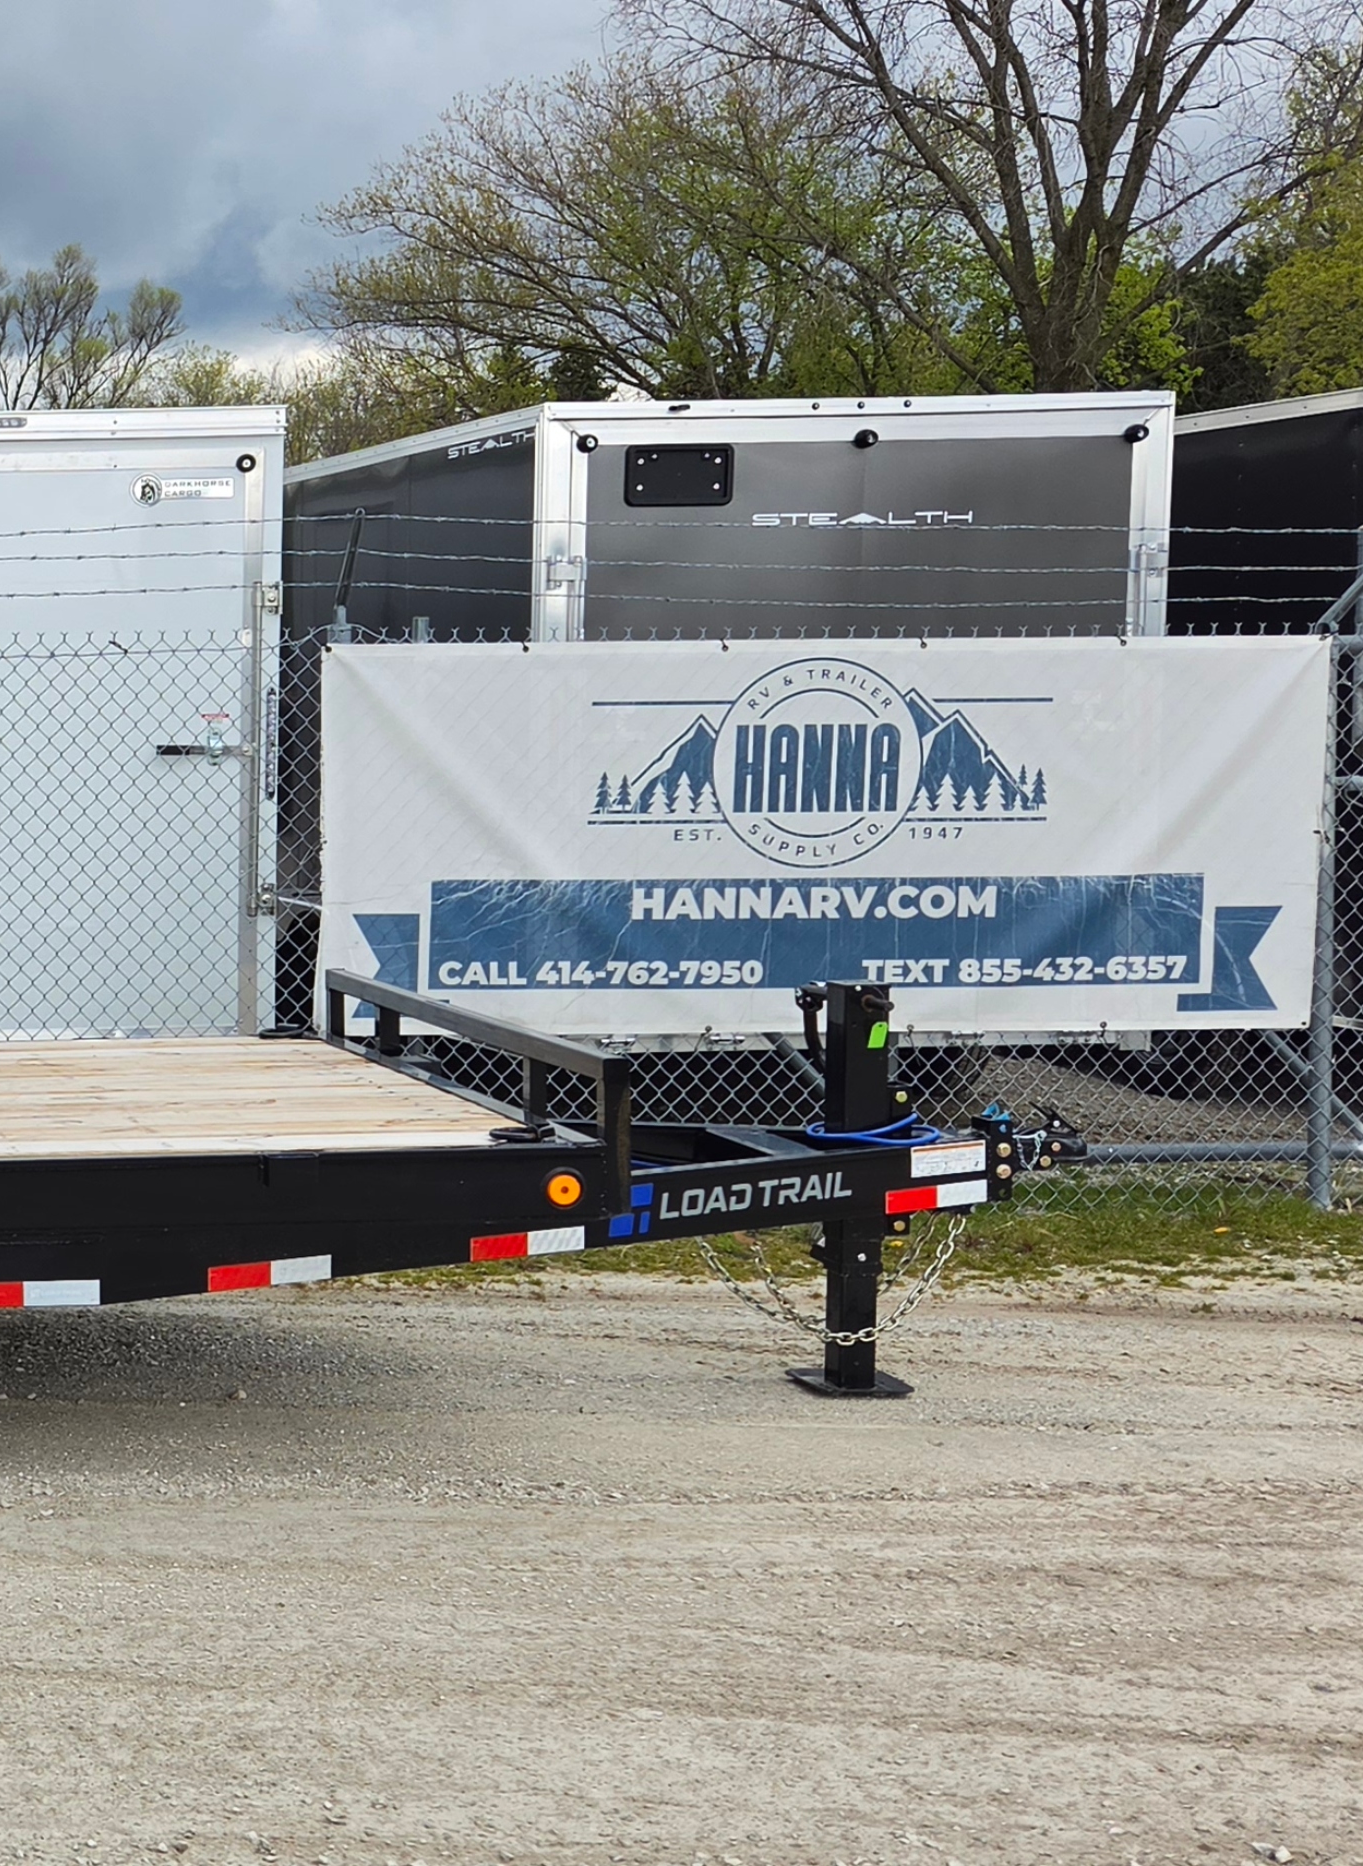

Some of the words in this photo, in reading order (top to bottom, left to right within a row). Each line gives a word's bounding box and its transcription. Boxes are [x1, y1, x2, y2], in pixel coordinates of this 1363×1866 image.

[164, 489, 202, 497] CARGO
[751, 510, 973, 527] STEALTH
[747, 686, 771, 710] RV
[806, 668, 893, 710] TRAILER
[731, 722, 902, 814] HANNA
[673, 828, 723, 842] EST.
[747, 823, 837, 858] SUPPLY
[853, 821, 885, 846] CO.
[908, 826, 964, 840] 1947
[631, 885, 998, 921] HANNARV.COM
[437, 960, 527, 986] CALL
[535, 959, 765, 986] 414-762-7950
[861, 957, 950, 984] TEXT
[958, 955, 1189, 984] 855-432-6357
[659, 1183, 753, 1221] LOAD
[758, 1171, 853, 1208] TRAIL
